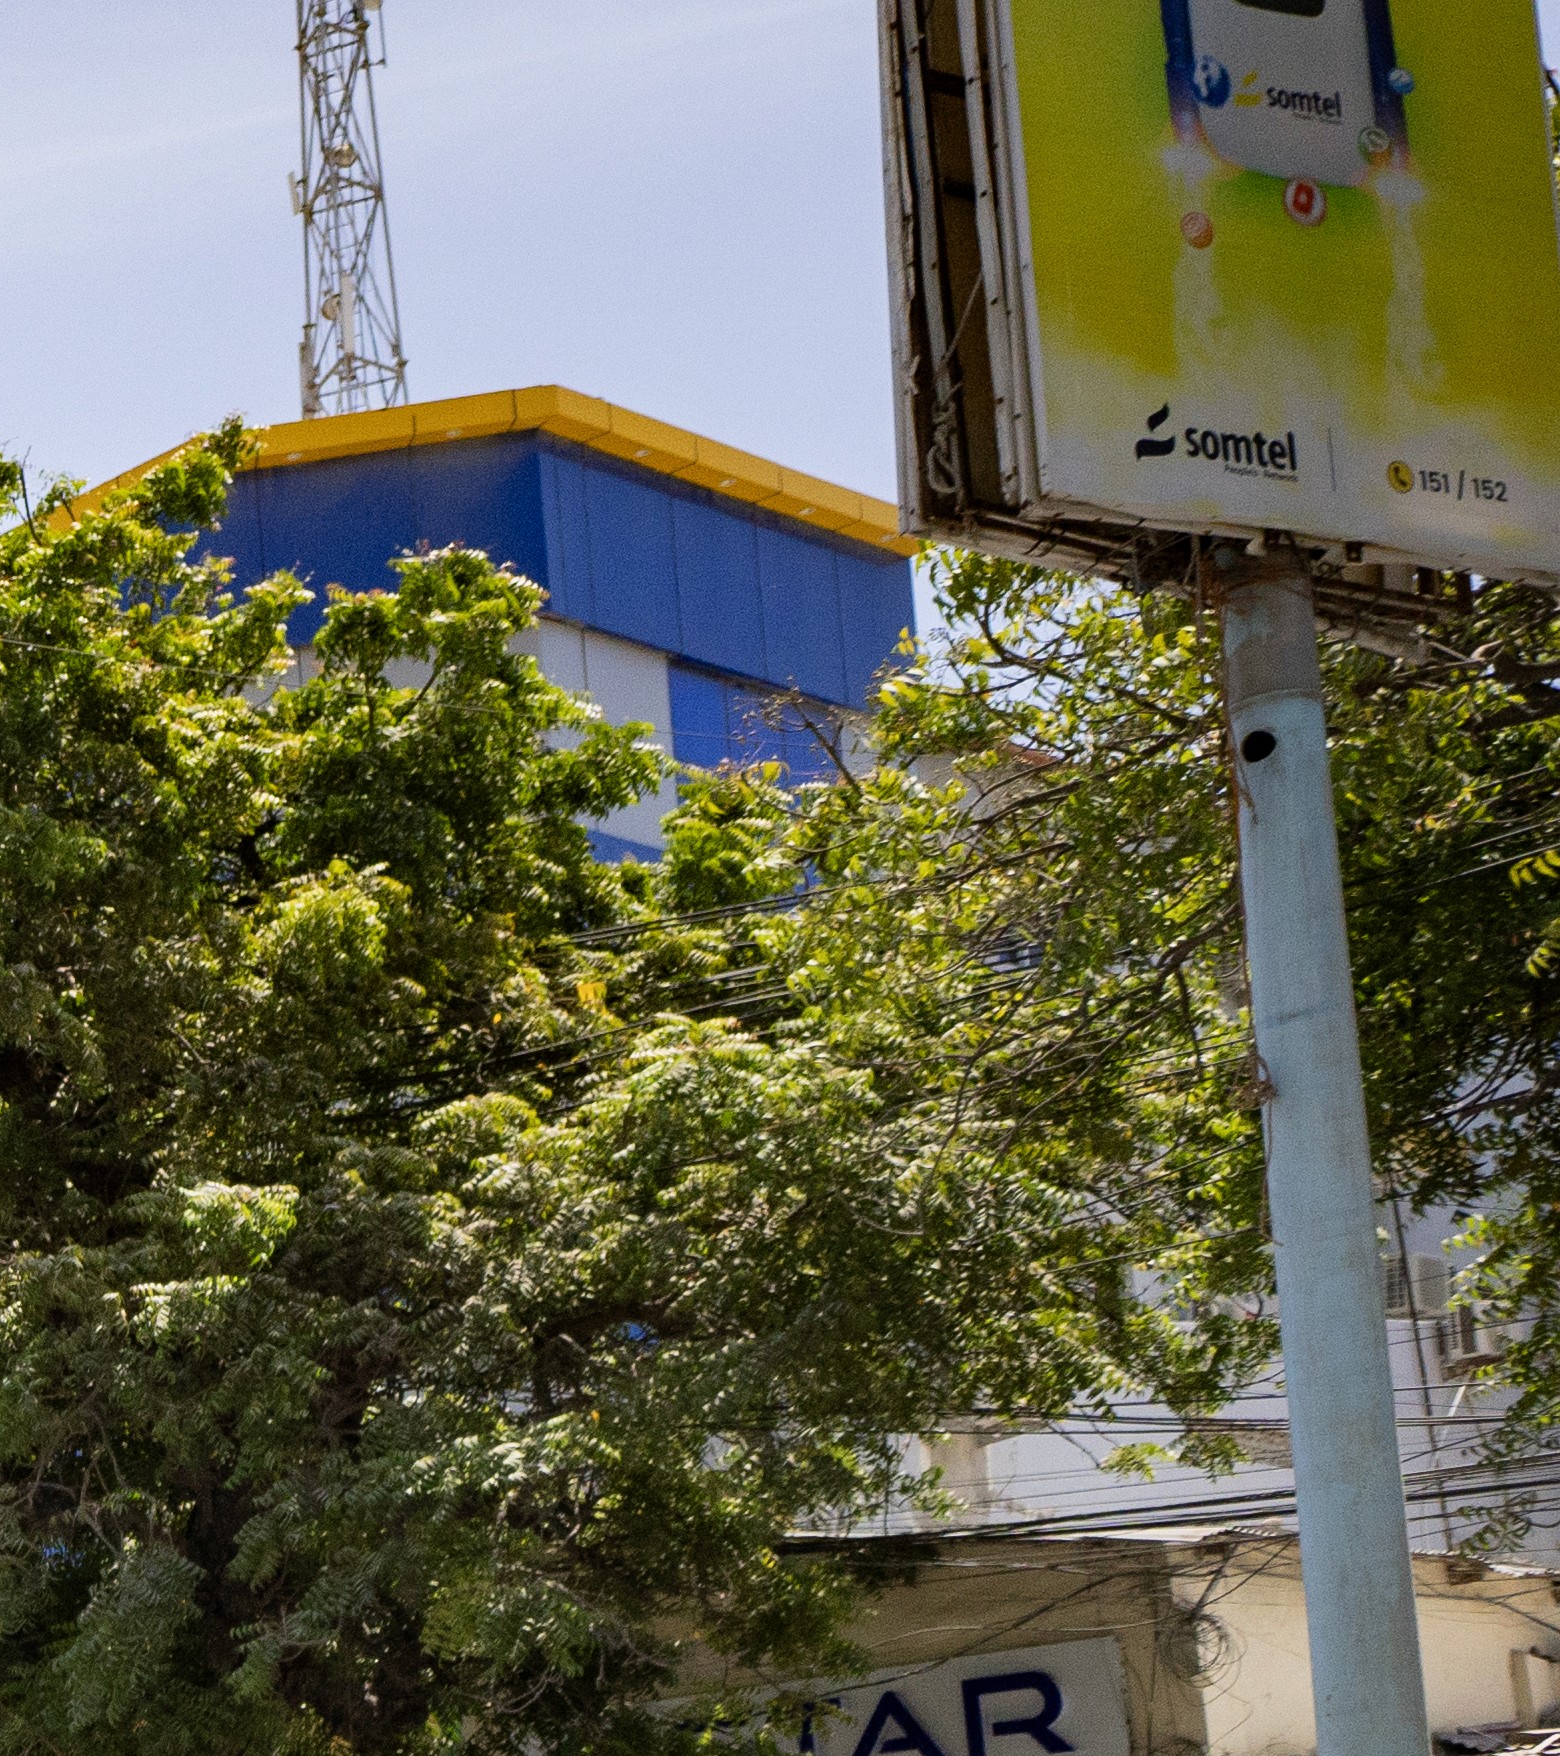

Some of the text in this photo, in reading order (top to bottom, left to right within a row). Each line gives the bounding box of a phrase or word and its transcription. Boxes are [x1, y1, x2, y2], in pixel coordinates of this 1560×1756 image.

[1266, 87, 1341, 118] somtel
[1184, 427, 1298, 471] somtel
[1419, 470, 1451, 493] 151
[1473, 478, 1510, 502] 152
